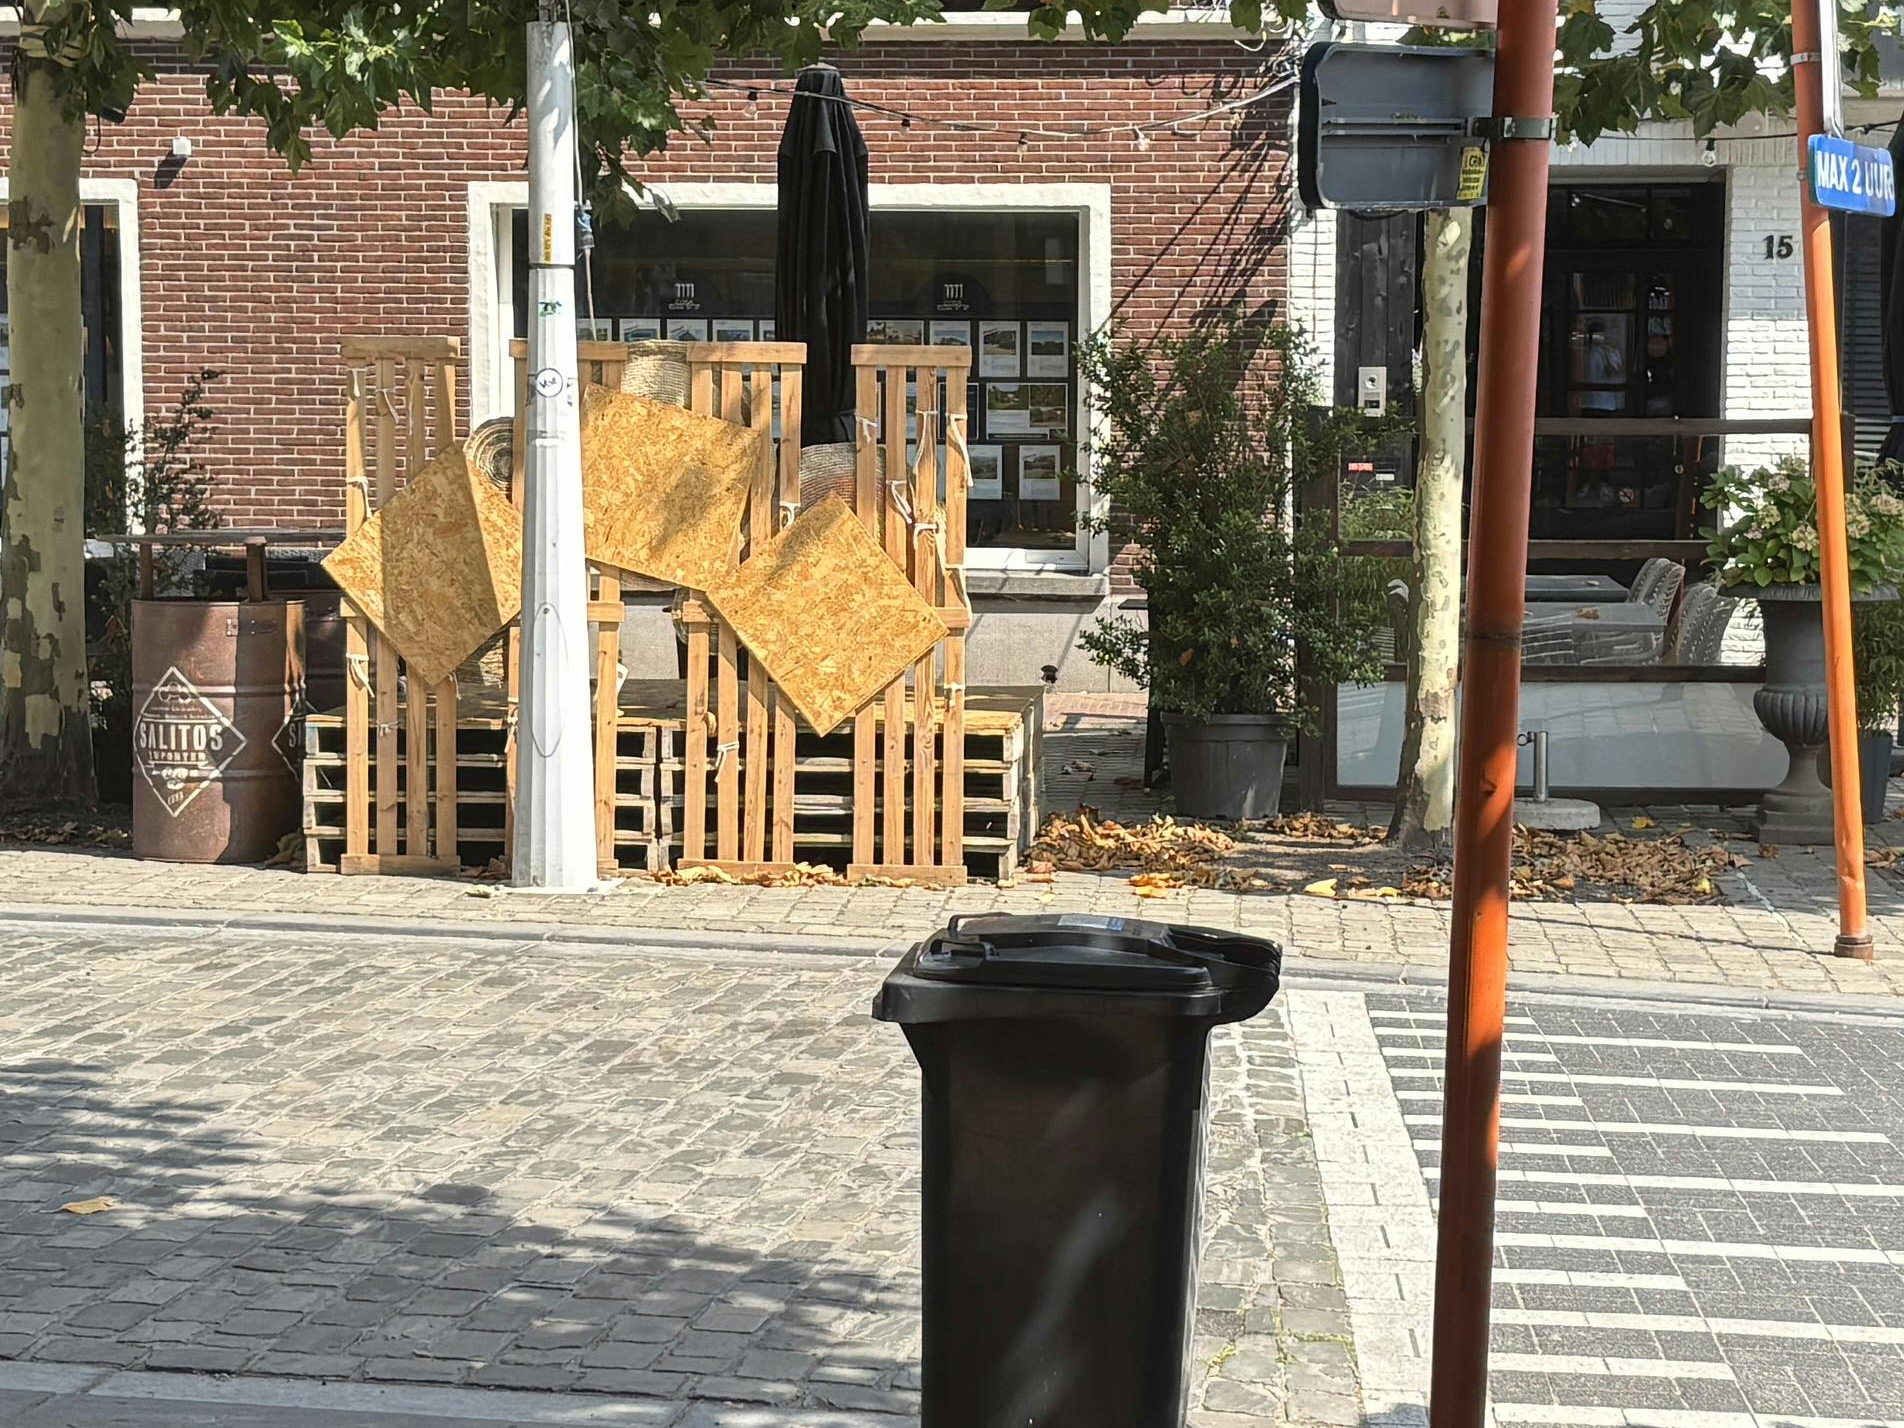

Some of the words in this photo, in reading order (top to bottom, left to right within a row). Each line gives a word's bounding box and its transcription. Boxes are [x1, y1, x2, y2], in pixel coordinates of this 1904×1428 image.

[1816, 150, 1849, 192] MAX
[1851, 158, 1862, 195] 2
[1864, 160, 1895, 201] UUR
[1763, 234, 1794, 261] 15
[139, 722, 223, 751] SALITOS
